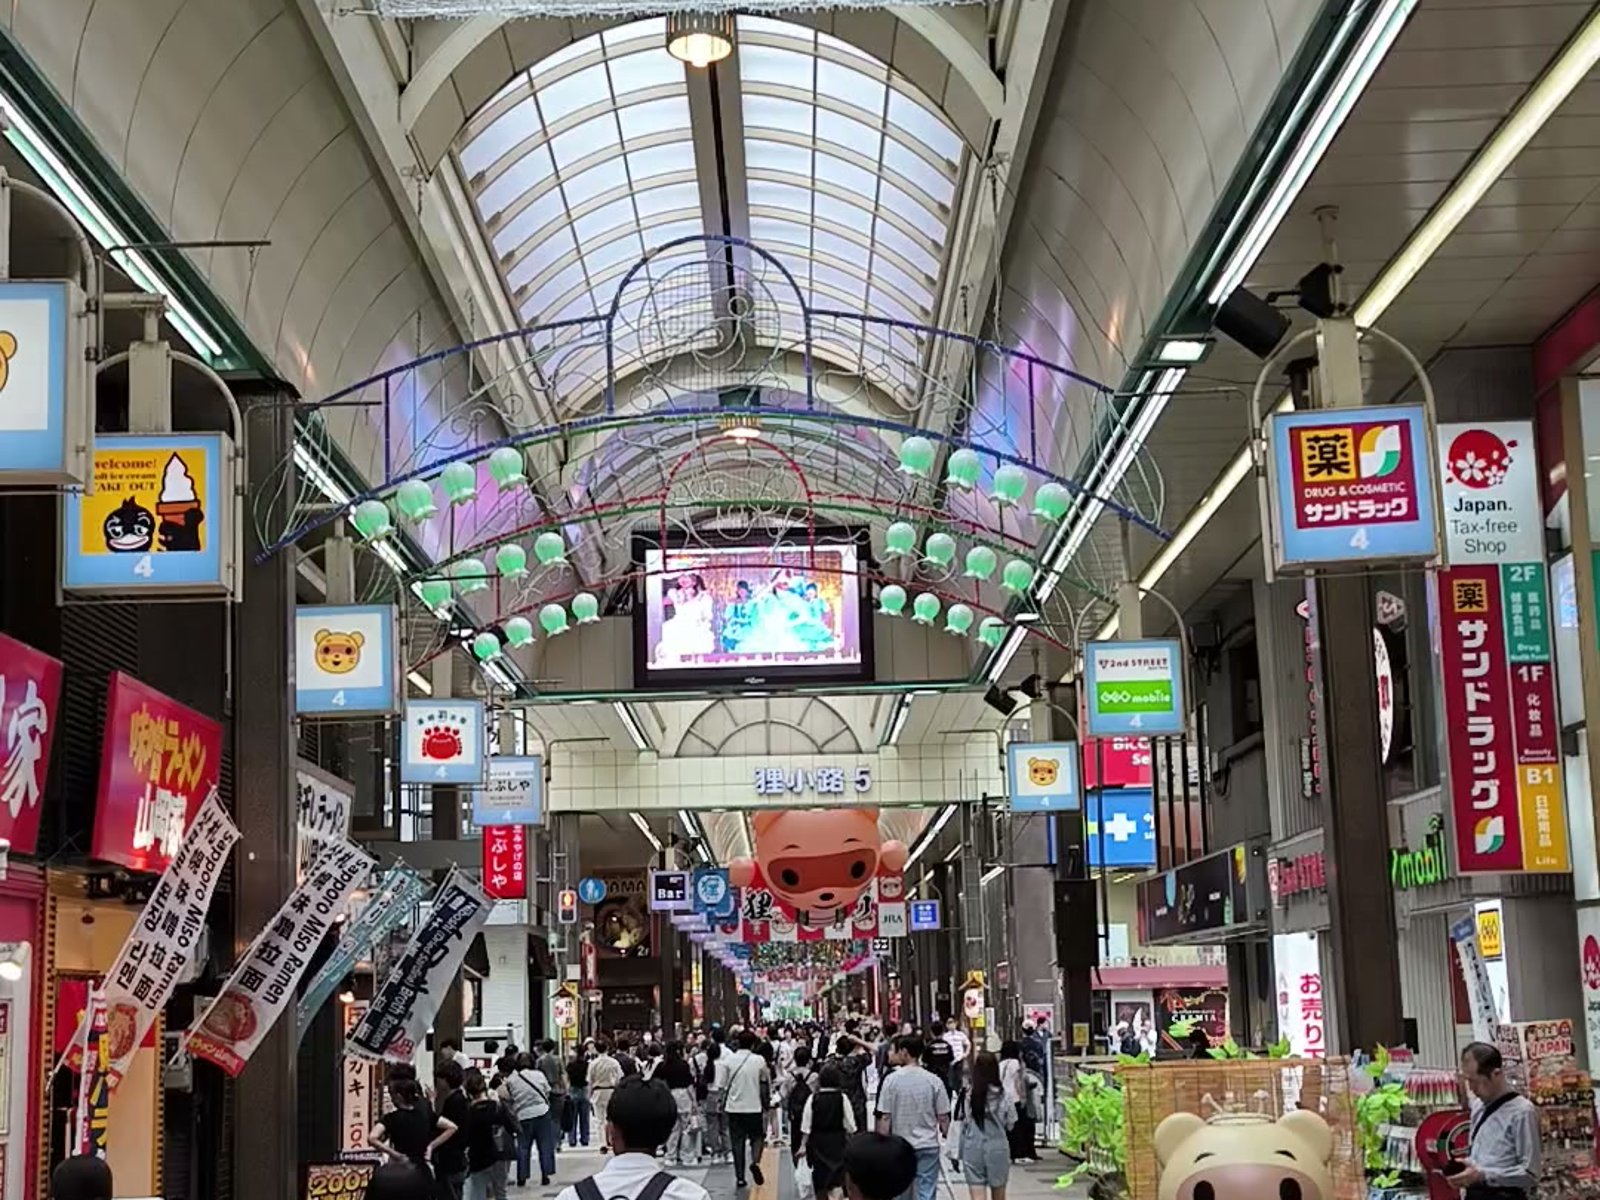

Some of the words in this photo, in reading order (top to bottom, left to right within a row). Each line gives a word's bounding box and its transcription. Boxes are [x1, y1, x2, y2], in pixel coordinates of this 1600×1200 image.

[1305, 434, 1350, 477] 薬
[95, 481, 122, 491] AKE
[129, 480, 155, 491] OUT
[1304, 487, 1336, 498] DRUG
[1339, 485, 1348, 496] &
[1349, 482, 1406, 495] COSMETIC
[1304, 498, 1409, 522] サンドラッグ
[1453, 497, 1513, 516] Japan.
[1452, 519, 1518, 534] Tax-free
[1350, 528, 1370, 550] 4
[1464, 538, 1506, 554] Shop
[133, 555, 154, 578] 4
[1510, 566, 1535, 582] 2F
[1457, 584, 1484, 609] 薬
[1110, 659, 1128, 667] 2nd
[1131, 658, 1167, 667] STREET
[1518, 666, 1543, 682] 1F
[331, 690, 346, 706] 4
[1131, 689, 1170, 703] mobile
[1129, 714, 1143, 727] 4
[1457, 619, 1500, 809] サンドラッグ
[0, 674, 48, 818] 家
[435, 765, 449, 778] 4
[755, 767, 844, 794] 狸小路
[855, 766, 872, 793] 5
[1526, 767, 1553, 784] B1
[199, 830, 234, 901] Sapporo
[317, 858, 369, 914] Sapporo
[657, 888, 684, 899] Bar
[179, 903, 204, 947] Miso
[293, 916, 326, 953] Miso
[147, 956, 186, 1010] Ramen
[262, 958, 305, 1005] Ramen
[389, 985, 414, 1016] Broth
[370, 1014, 400, 1048] Ramen
